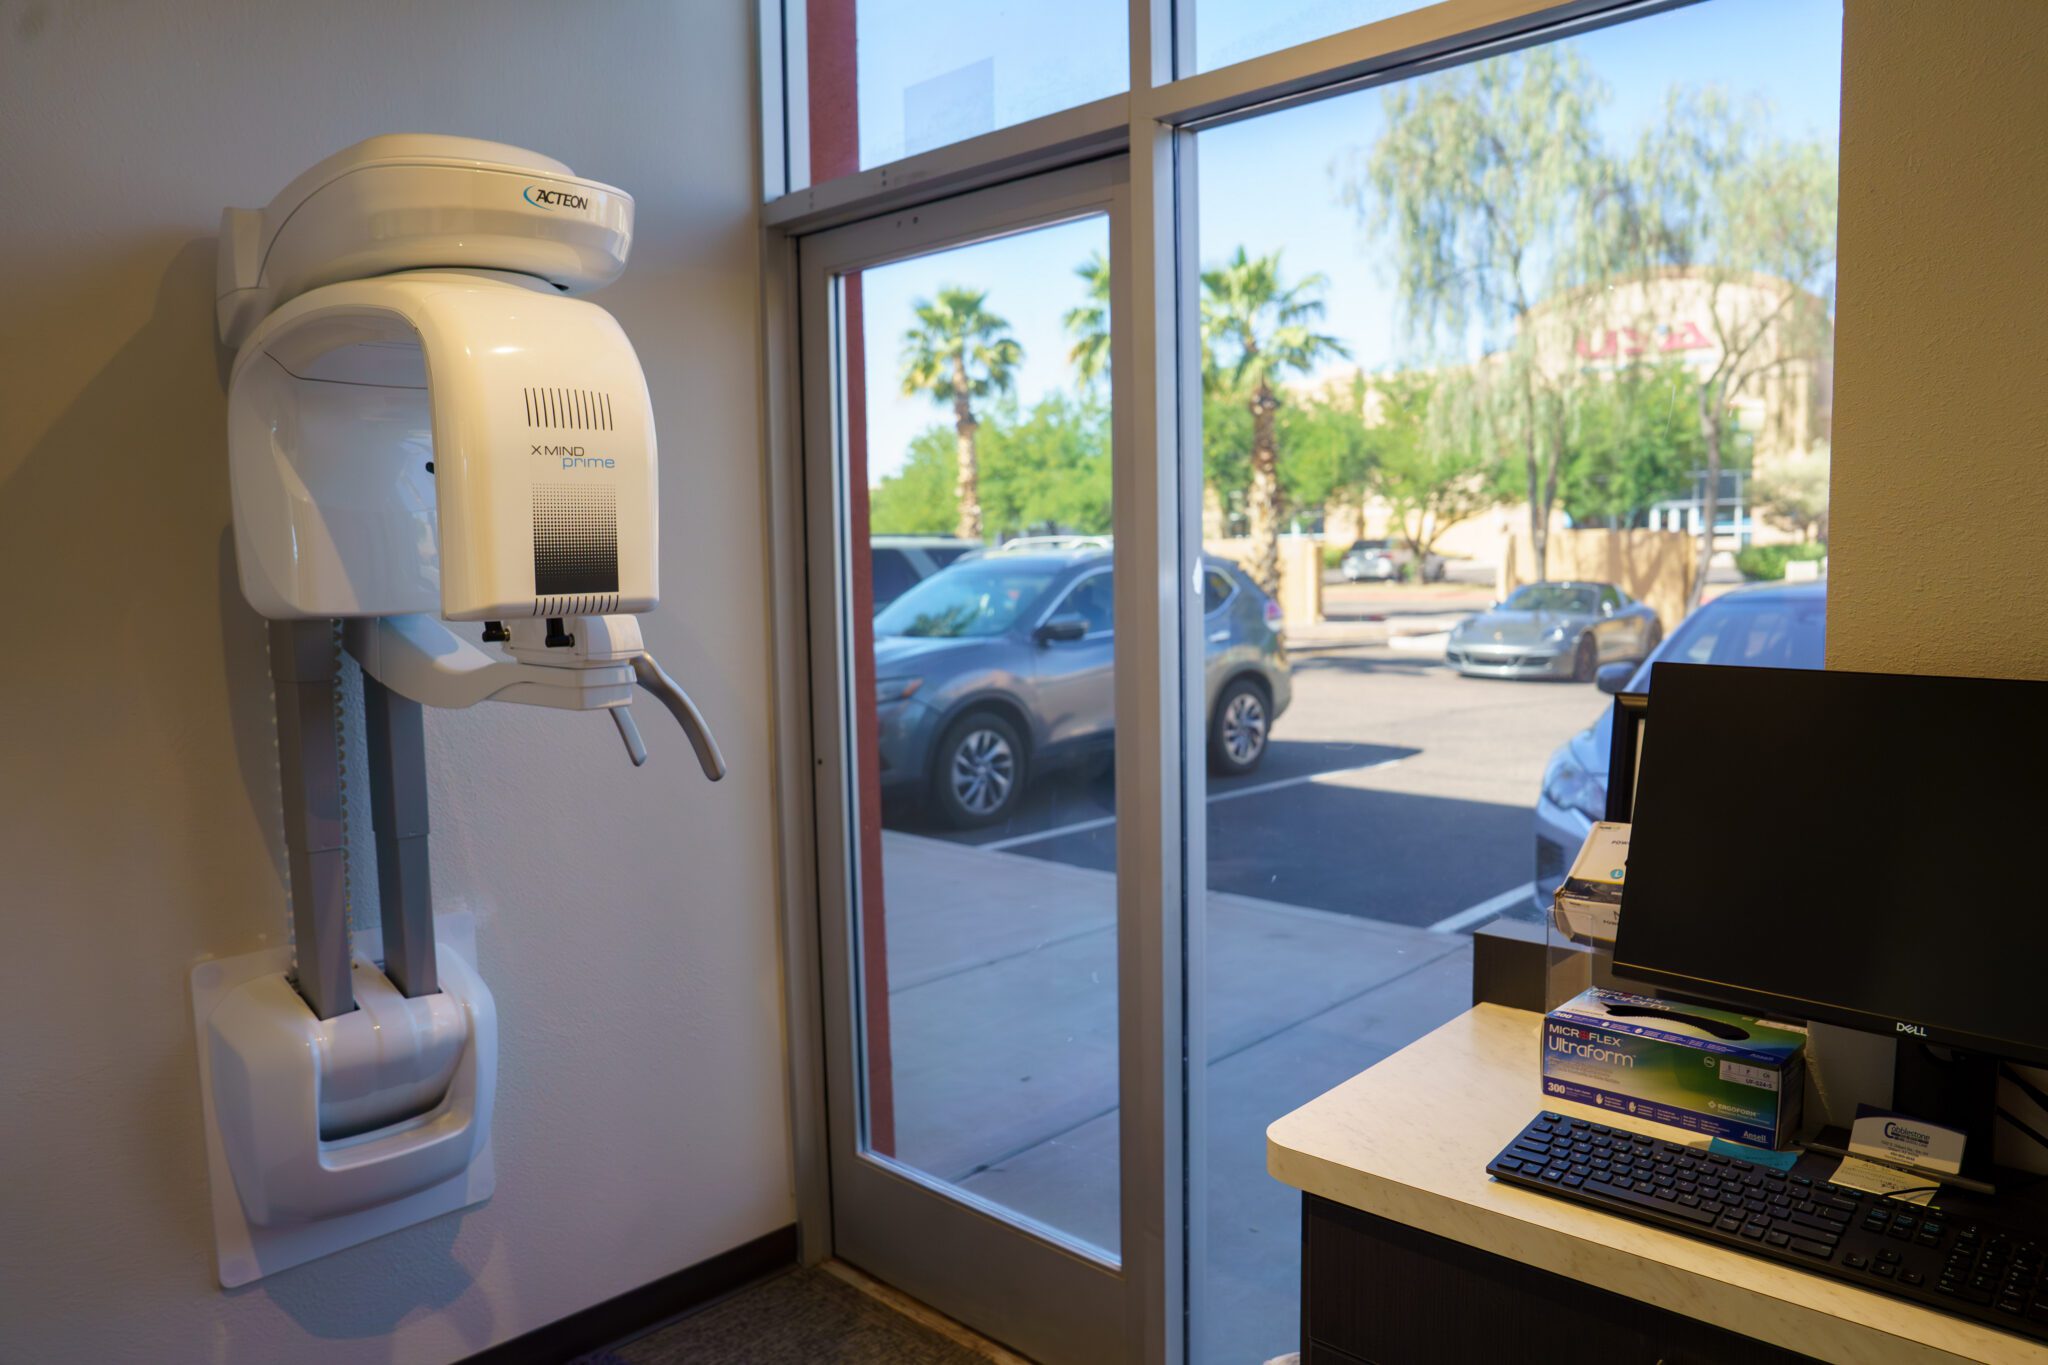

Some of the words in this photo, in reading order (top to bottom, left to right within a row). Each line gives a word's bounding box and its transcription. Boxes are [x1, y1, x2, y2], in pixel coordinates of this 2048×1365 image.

[535, 189, 589, 210] ACTEON
[545, 446, 584, 457] MIND
[562, 457, 615, 470] prime
[1549, 1023, 1622, 1047] MICROFLEX
[1896, 1022, 1927, 1037] DELL
[1549, 1035, 1634, 1068] Ultraform
[1548, 1082, 1566, 1095] 300
[1743, 1130, 1767, 1142] Ansell
[1884, 1121, 1931, 1141] Cobblestone
